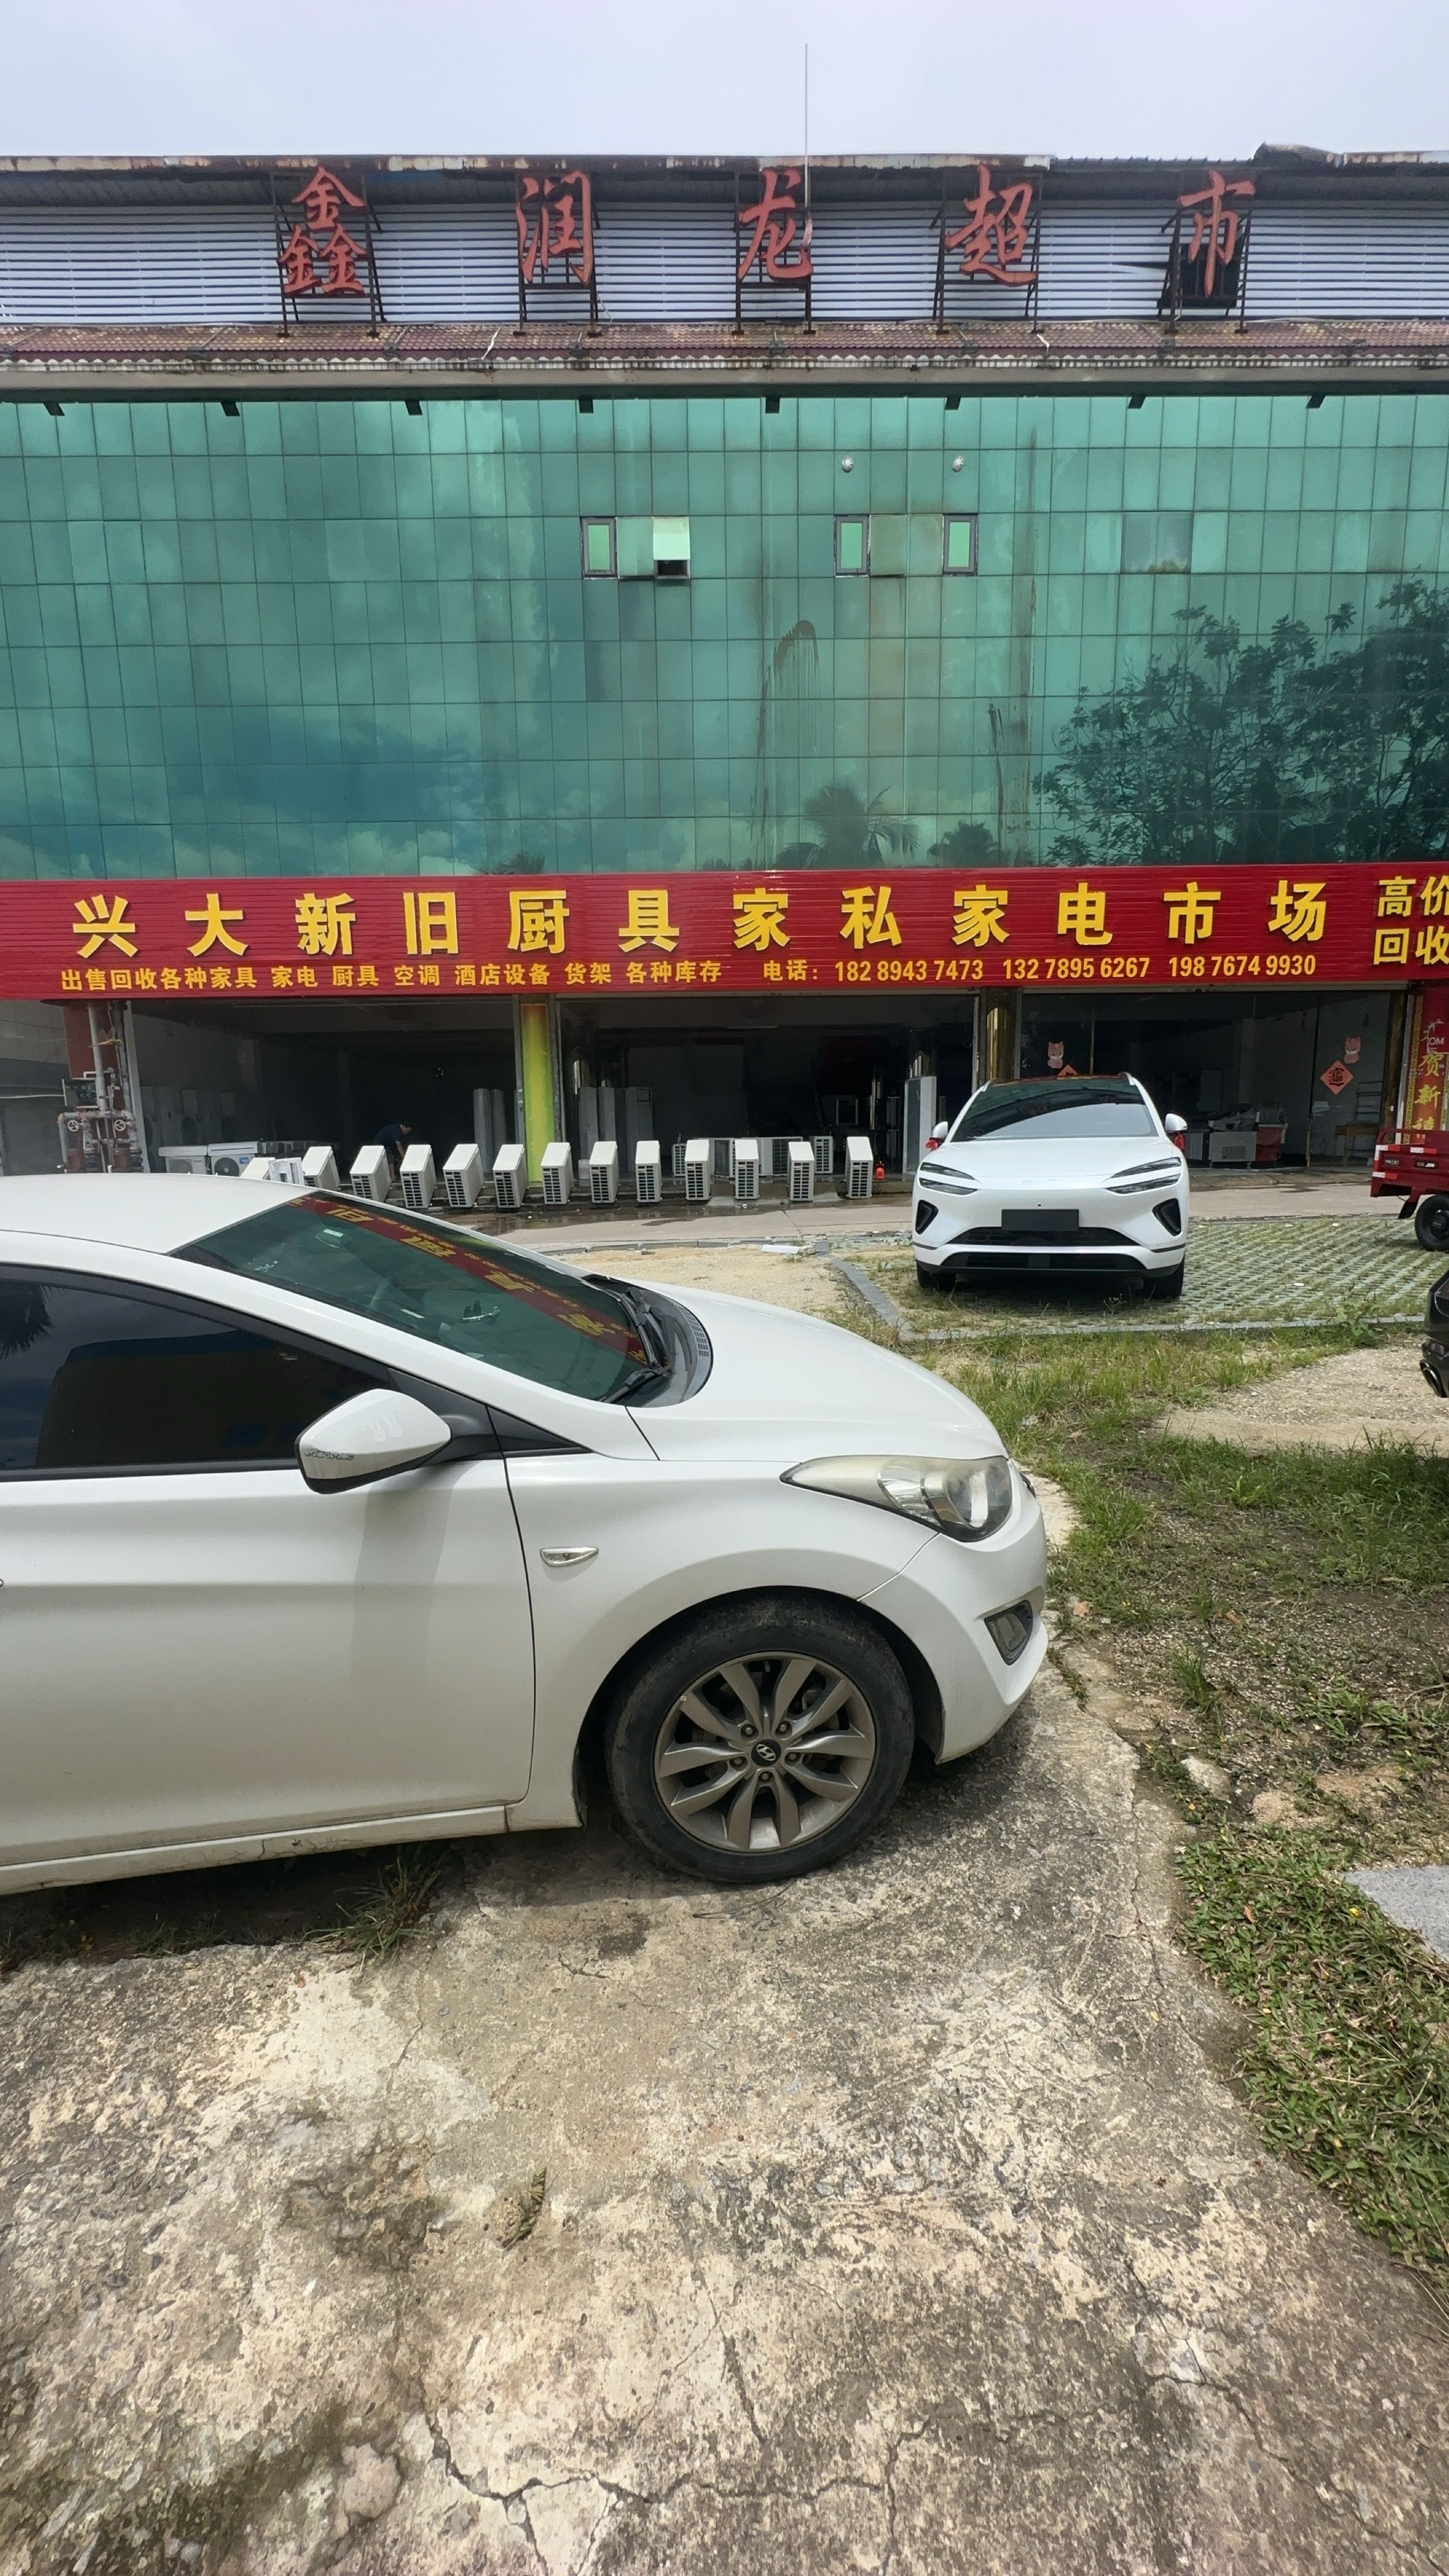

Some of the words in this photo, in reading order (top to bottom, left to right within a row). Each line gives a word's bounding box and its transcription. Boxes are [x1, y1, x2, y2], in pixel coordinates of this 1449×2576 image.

[277, 163, 1255, 298] 鑫润龙超市
[1378, 875, 1449, 917] 高价
[73, 880, 1327, 959] 兴大新旧厨具家私家电市场
[1373, 926, 1449, 965] 回收
[61, 967, 257, 991] 出售回收各种家具
[272, 966, 317, 988] 家电
[332, 965, 378, 987] 厨具
[394, 964, 440, 986] 空调
[455, 962, 550, 986] 酒店设备
[565, 962, 611, 984] 货架
[627, 960, 721, 984] 各种库存
[835, 961, 872, 982] 182
[877, 960, 927, 981] 8943
[934, 959, 983, 980] 7473
[1003, 958, 1038, 979] 132
[1045, 958, 1094, 979] 7895
[1100, 957, 1150, 978] 6267
[1169, 956, 1205, 977] 198
[1211, 956, 1260, 976] 7674
[1266, 955, 1316, 976] 9930
